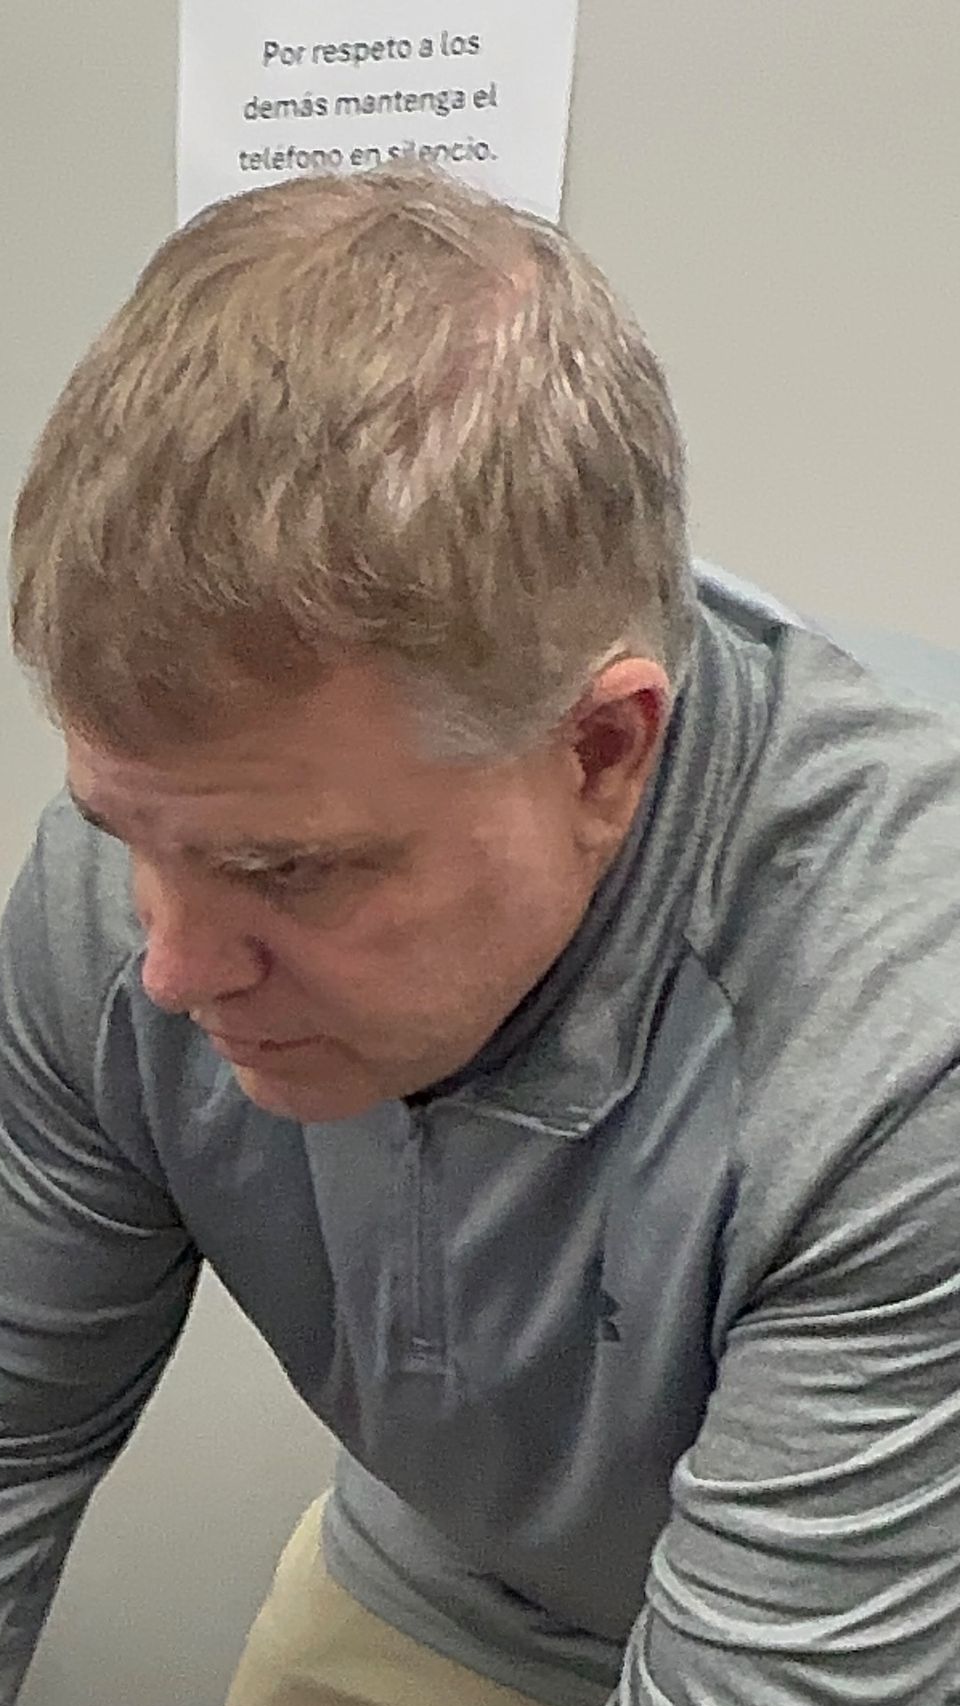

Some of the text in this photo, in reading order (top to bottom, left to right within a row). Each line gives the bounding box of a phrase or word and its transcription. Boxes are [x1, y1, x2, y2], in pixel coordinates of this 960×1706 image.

[263, 31, 481, 68] Por respeto a los
[243, 82, 498, 120] demás mantenga el
[350, 147, 381, 167] en
